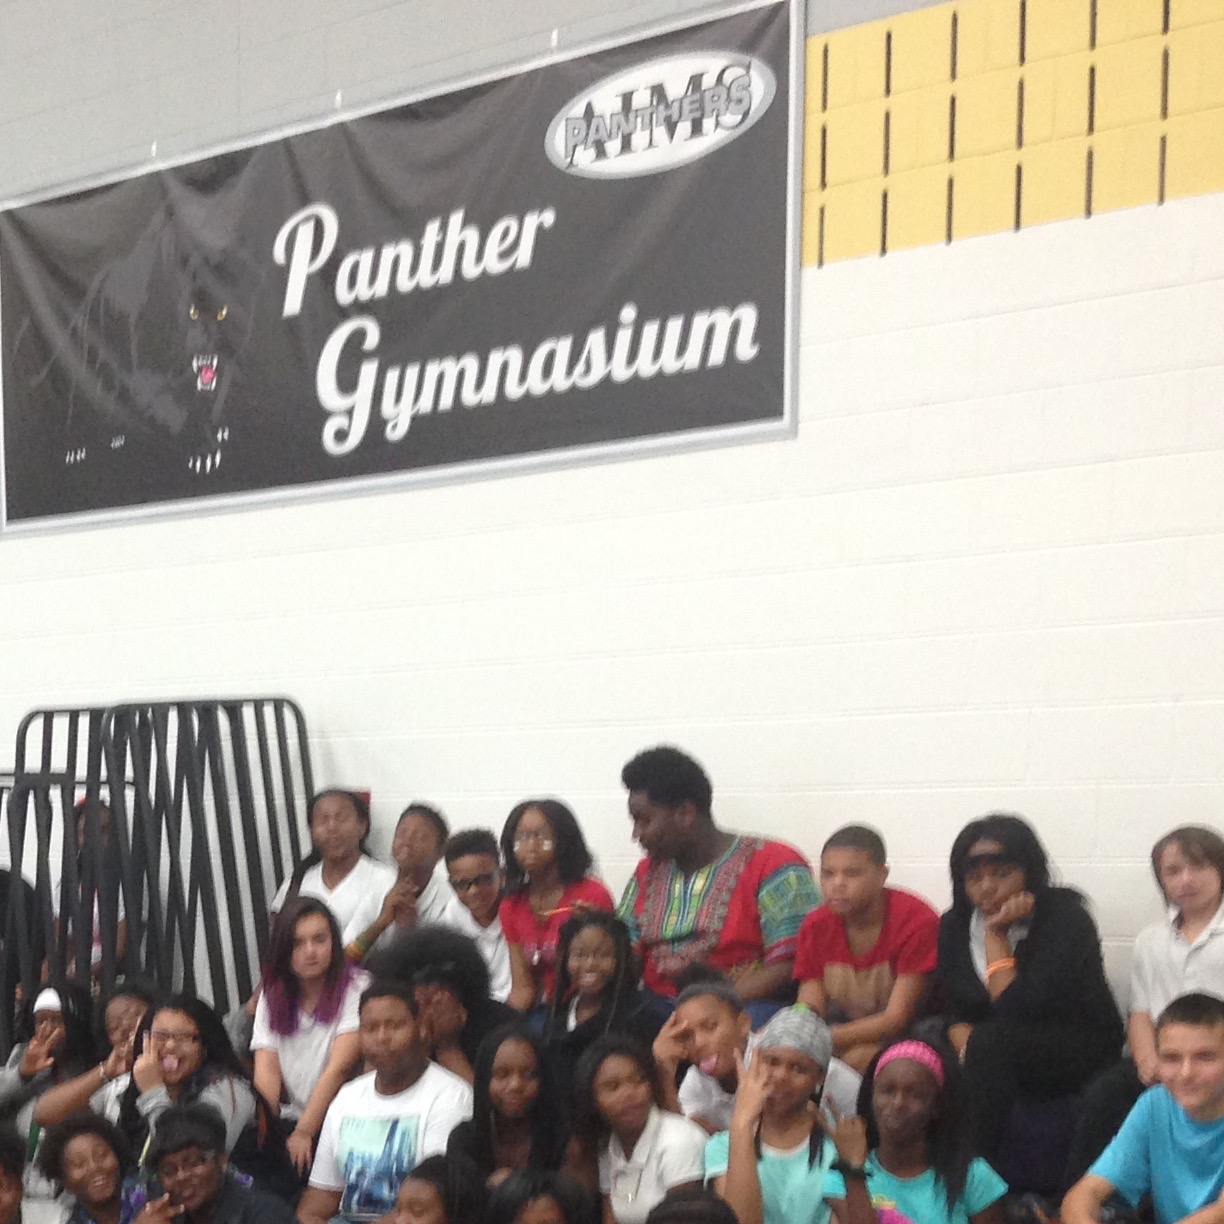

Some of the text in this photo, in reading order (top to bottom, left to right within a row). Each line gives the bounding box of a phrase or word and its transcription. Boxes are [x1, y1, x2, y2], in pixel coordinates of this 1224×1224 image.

[564, 73, 751, 159] PANTHERS
[274, 202, 556, 318] Panther
[316, 302, 759, 456] Gymnasium
